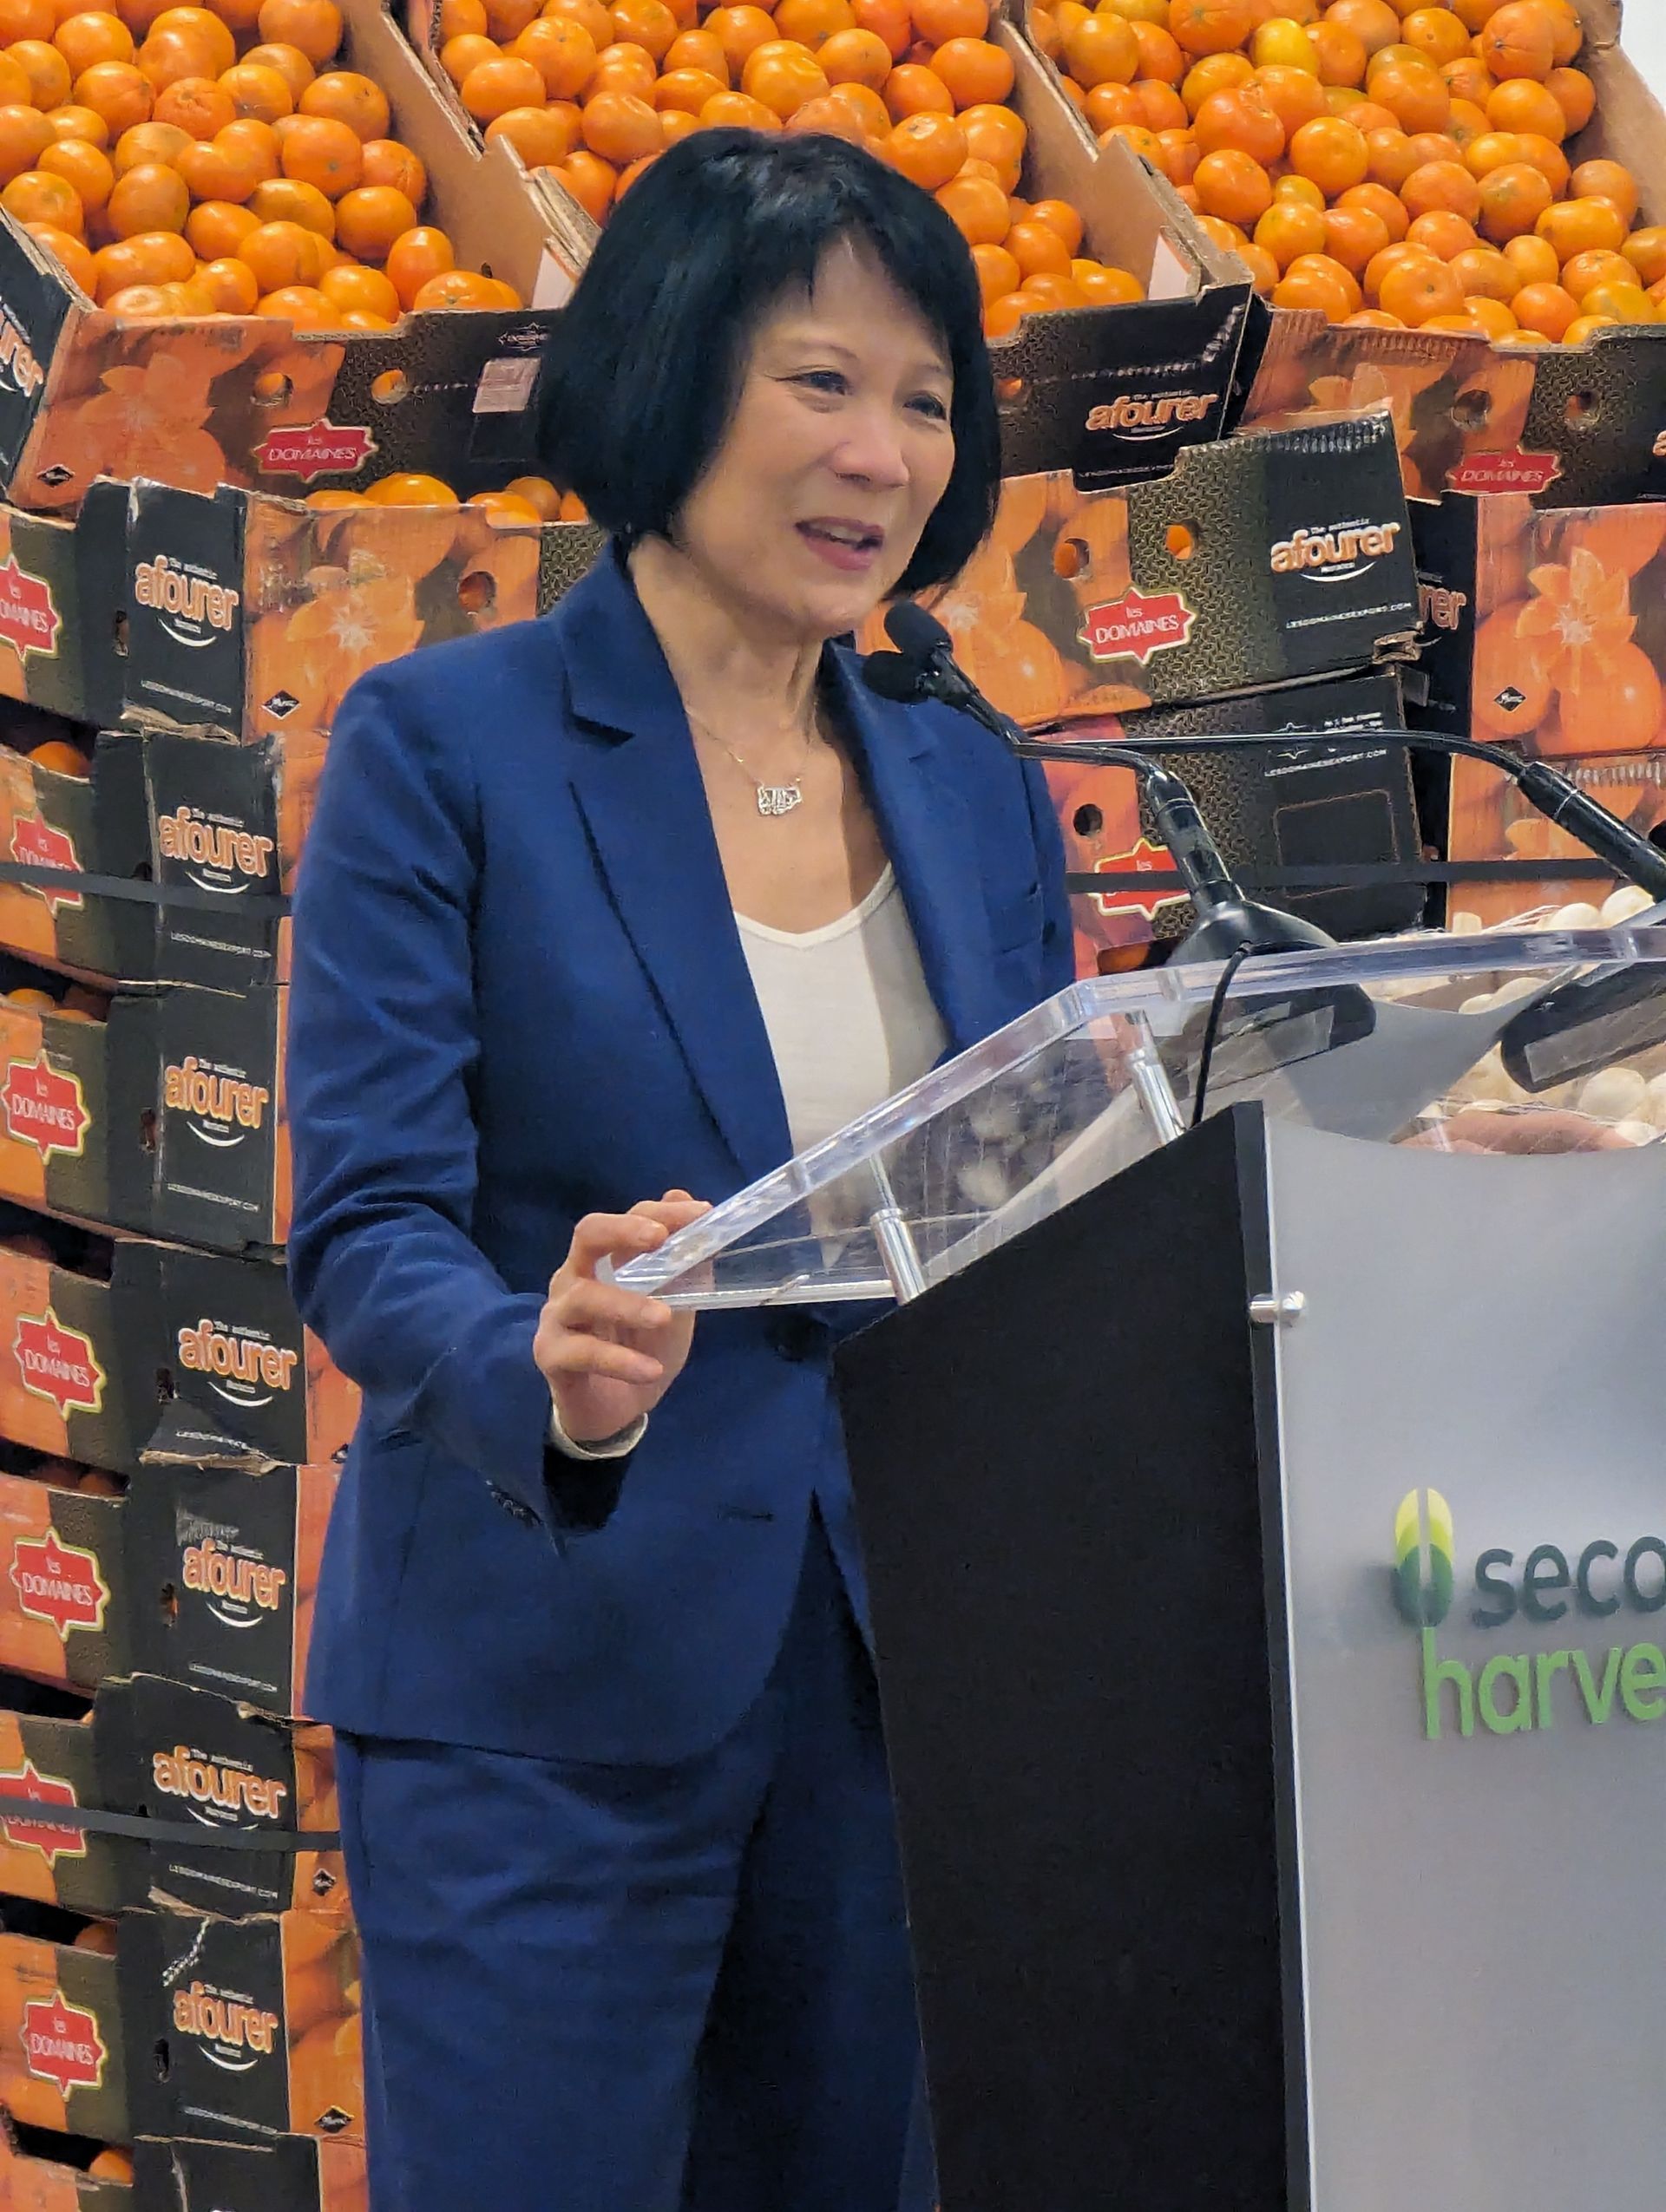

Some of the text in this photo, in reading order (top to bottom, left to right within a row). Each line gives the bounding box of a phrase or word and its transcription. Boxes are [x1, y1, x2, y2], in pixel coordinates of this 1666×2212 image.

[1086, 395, 1219, 431] afourer
[1270, 522, 1401, 573] afourer
[136, 554, 239, 632] afourer
[1095, 614, 1179, 644] DOMAINES
[159, 806, 273, 878] afourer
[165, 1056, 269, 1129] afourer
[178, 1319, 298, 1391] afourer
[22, 1572, 94, 1606] DOMAINES
[182, 1537, 286, 1610] afourer
[1473, 1535, 1666, 1627] seco
[1422, 1626, 1666, 1740] harve
[153, 1745, 287, 1819] afourer
[174, 1980, 279, 2054] afourer
